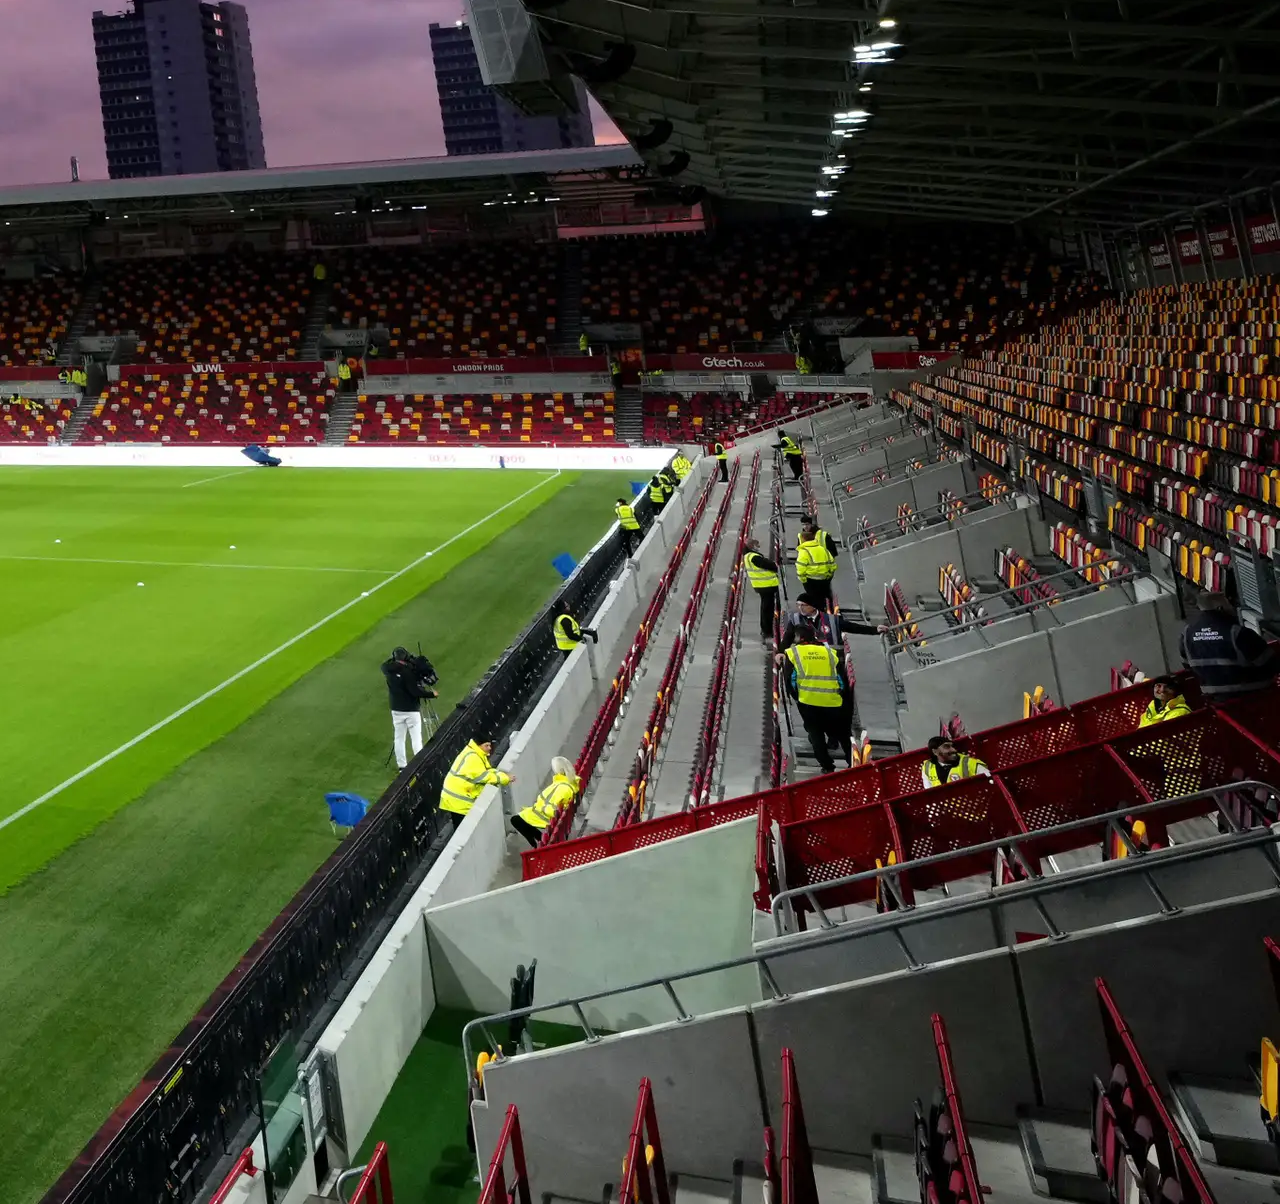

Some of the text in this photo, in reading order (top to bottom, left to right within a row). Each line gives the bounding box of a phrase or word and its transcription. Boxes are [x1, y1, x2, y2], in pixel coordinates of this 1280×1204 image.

[702, 356, 766, 368] Gtech.co.uk
[452, 363, 505, 372] LONDON PRIDE
